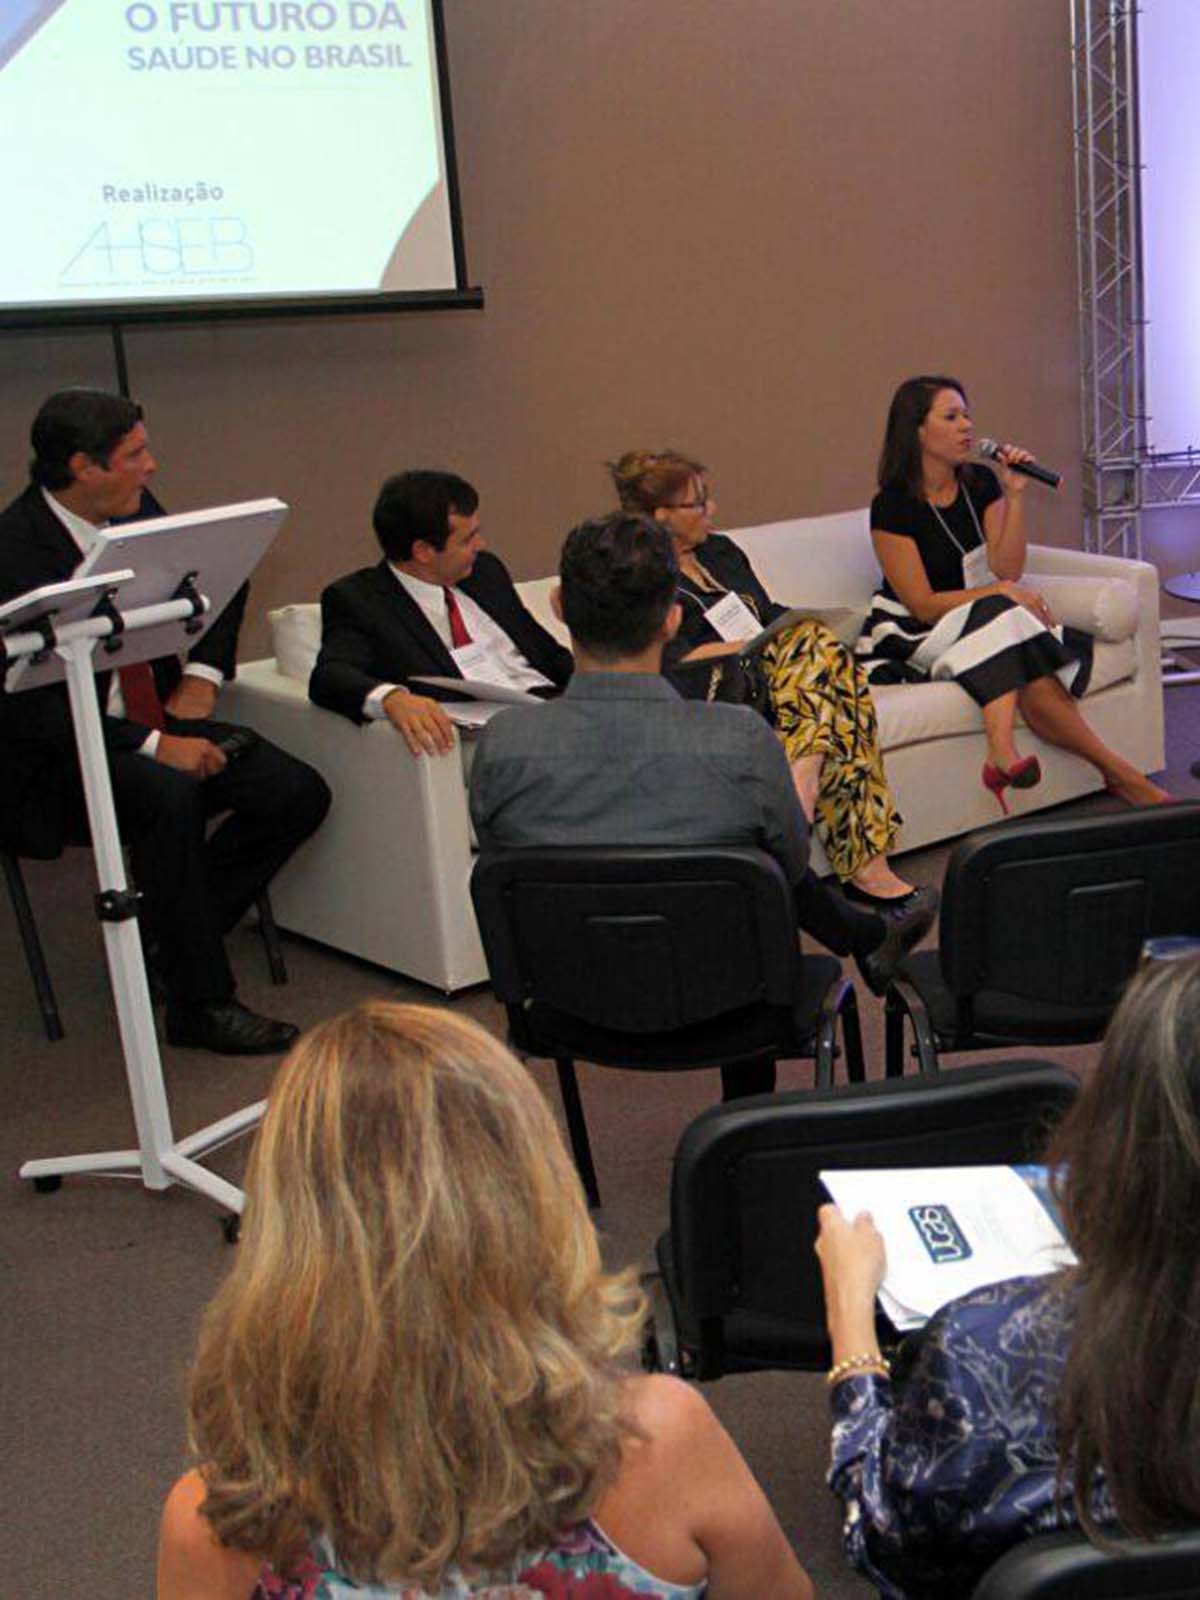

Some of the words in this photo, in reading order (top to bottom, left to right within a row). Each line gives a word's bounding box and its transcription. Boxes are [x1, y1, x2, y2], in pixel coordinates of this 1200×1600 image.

[125, 1, 158, 32] O
[170, 1, 337, 32] FUTURO
[349, 0, 407, 30] DA
[127, 38, 238, 70] SAÚDE
[246, 46, 296, 69] NO
[305, 44, 413, 69] BRASIL
[102, 181, 224, 205] Realização
